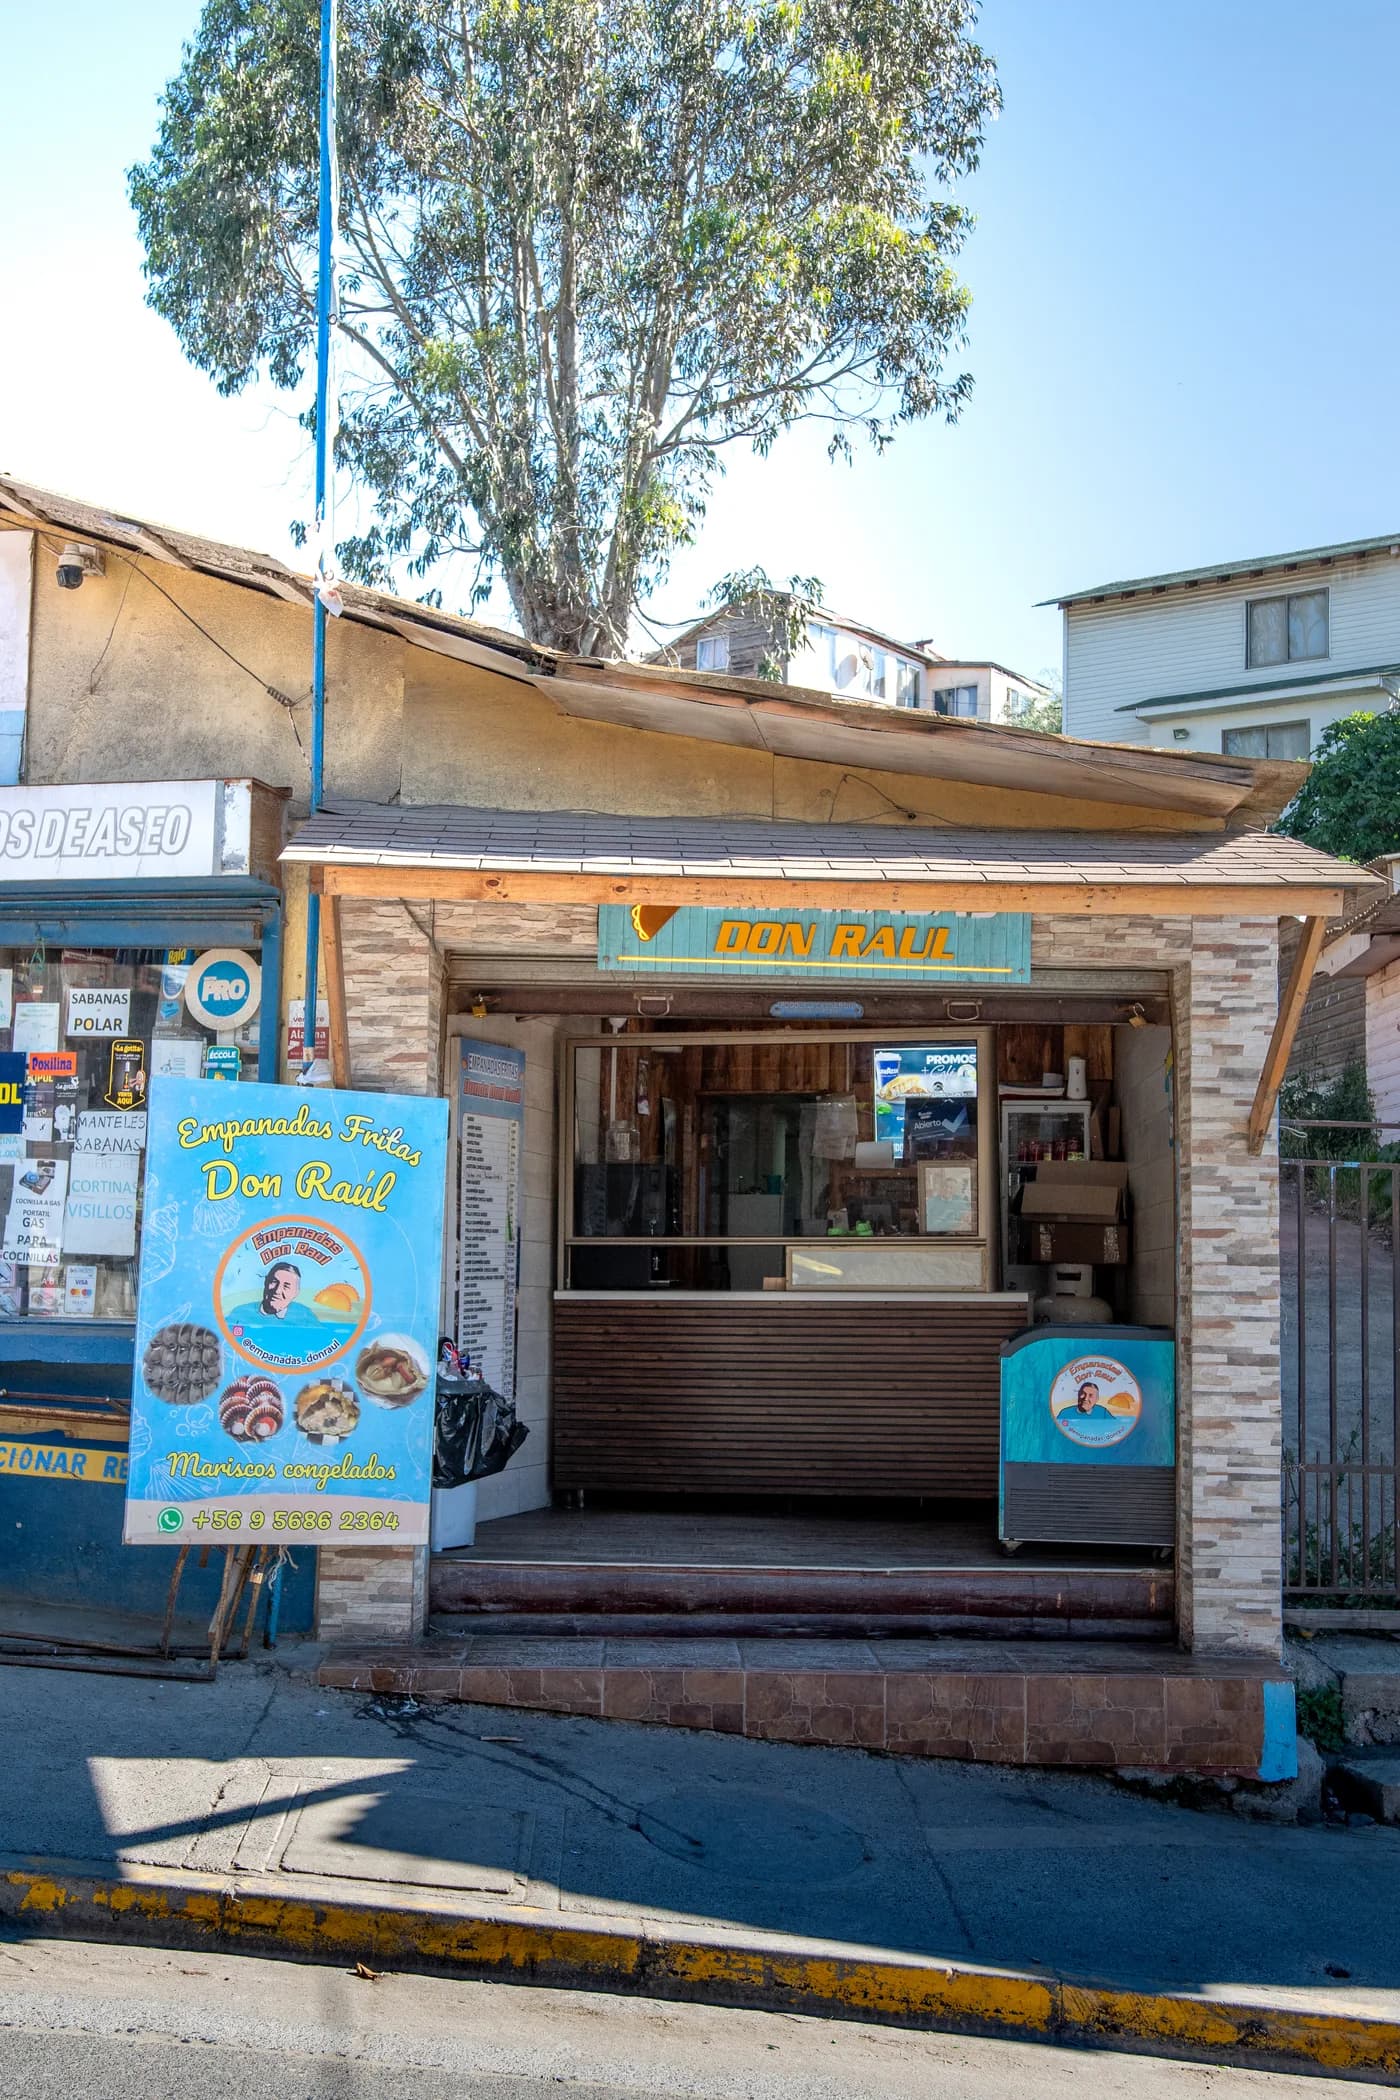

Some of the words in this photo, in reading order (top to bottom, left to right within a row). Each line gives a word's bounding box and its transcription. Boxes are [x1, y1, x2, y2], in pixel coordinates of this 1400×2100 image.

[34, 808, 92, 858] DE
[84, 804, 192, 857] ASEO
[715, 921, 816, 956] DON
[829, 924, 956, 960] RAUL
[71, 993, 128, 1005] SABANAS
[73, 1018, 122, 1031] POLAR
[32, 1056, 72, 1071] Poxilina
[926, 1054, 977, 1065] PROMOS
[77, 1114, 147, 1129] MANTELES
[914, 1119, 941, 1130] Abierto
[177, 1104, 333, 1151] Empanadas
[339, 1115, 423, 1167] Fritas
[75, 1137, 141, 1152] SABANAS
[71, 1180, 137, 1193] CORTINAS
[201, 1160, 282, 1202] Don
[295, 1160, 397, 1213] Raúl
[67, 1203, 134, 1220] VISILLOS
[22, 1217, 45, 1228] GAS
[17, 1234, 47, 1245] PARA
[252, 1226, 344, 1256] Empanadas
[2, 1251, 58, 1263] COCINILLAS
[260, 1243, 292, 1266] Don
[294, 1242, 333, 1267] Raul
[242, 1338, 341, 1365] @empanadas_donraul
[1068, 1360, 1123, 1377] Empanadas
[1074, 1371, 1094, 1385] Don
[166, 1452, 276, 1478] Mariscos
[282, 1454, 396, 1490] congelados
[192, 1510, 242, 1531] +56
[249, 1511, 265, 1530] 9
[272, 1511, 332, 1531] 5686
[339, 1511, 399, 1531] 2364
